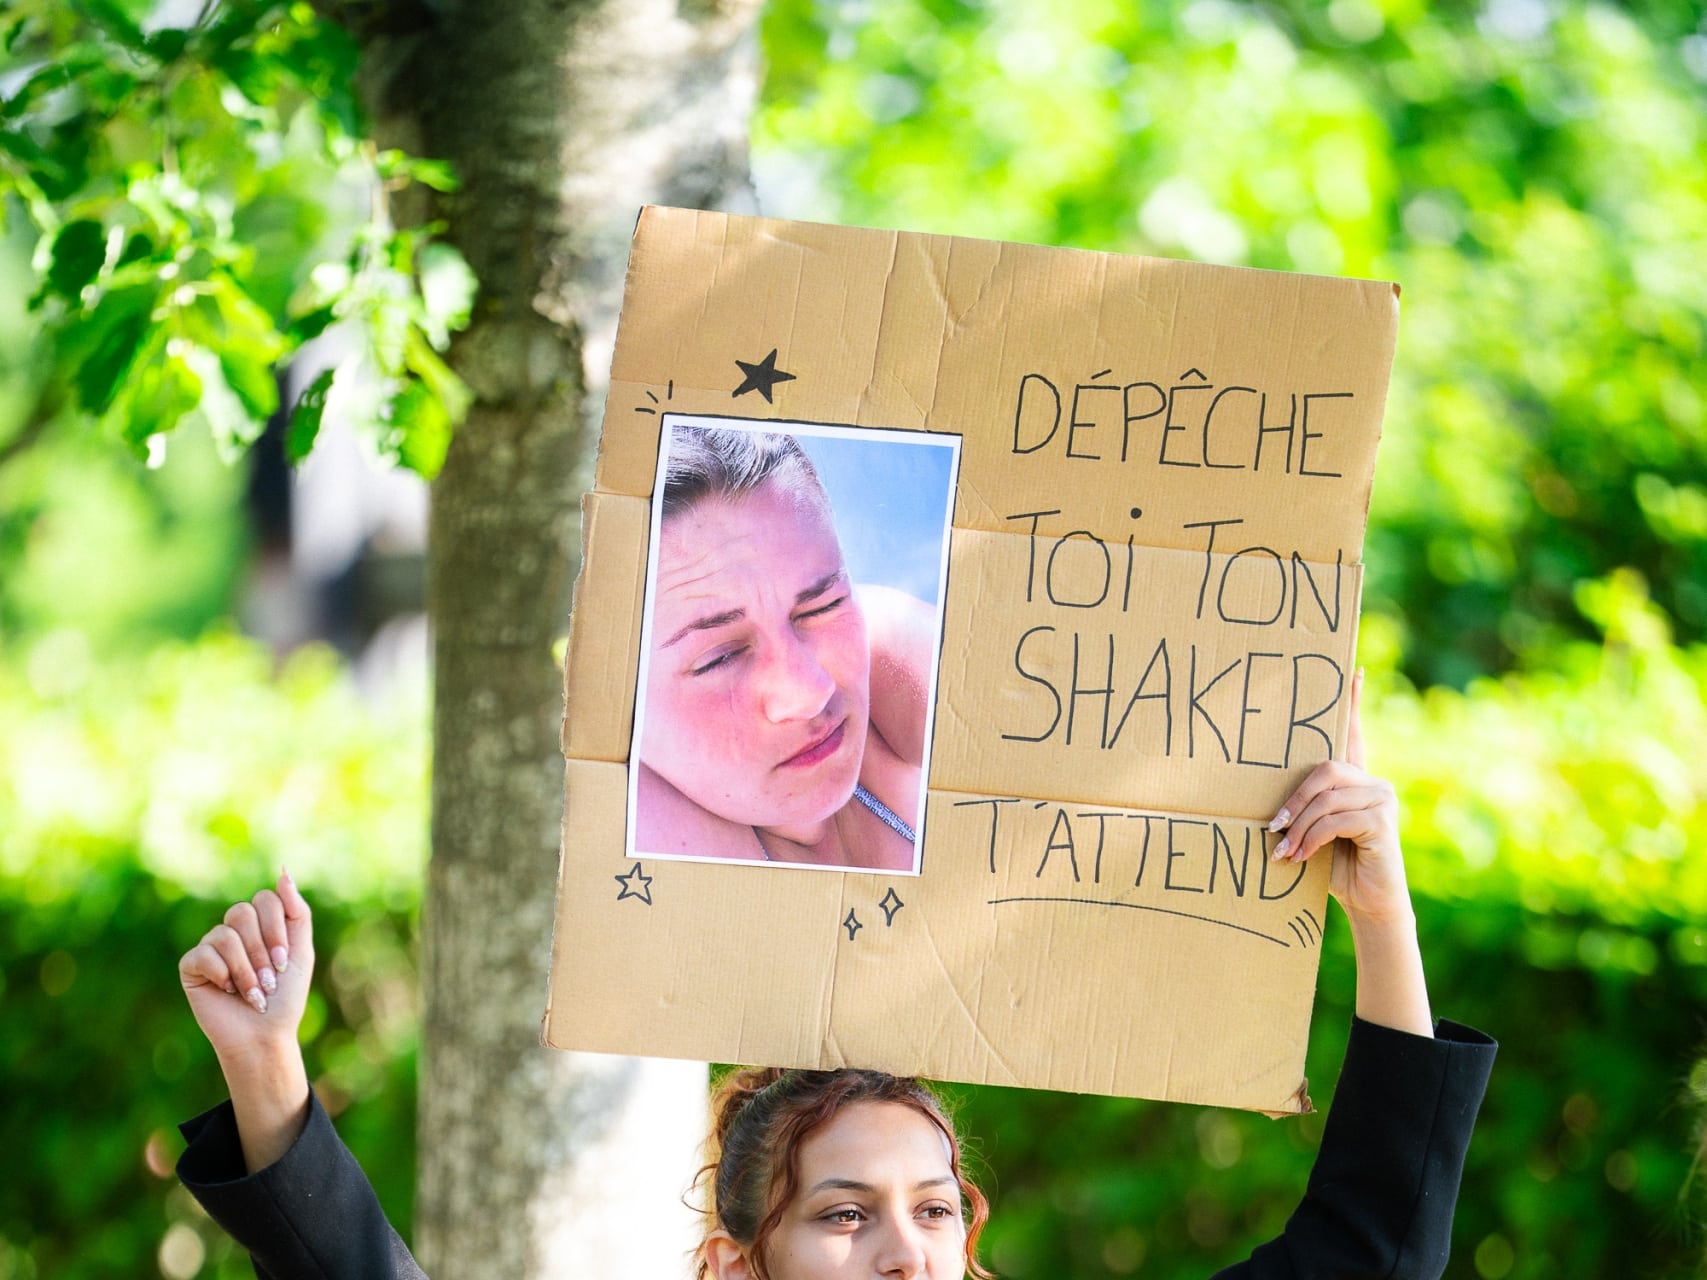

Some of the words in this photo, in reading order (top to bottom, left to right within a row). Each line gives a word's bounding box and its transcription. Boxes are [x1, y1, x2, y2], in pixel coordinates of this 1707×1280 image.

[1011, 367, 1355, 479] DÉPÊCHE
[1183, 519, 1343, 633] TON
[1001, 625, 1345, 770] SHAKER
[953, 799, 1308, 901] T'ATTEND
